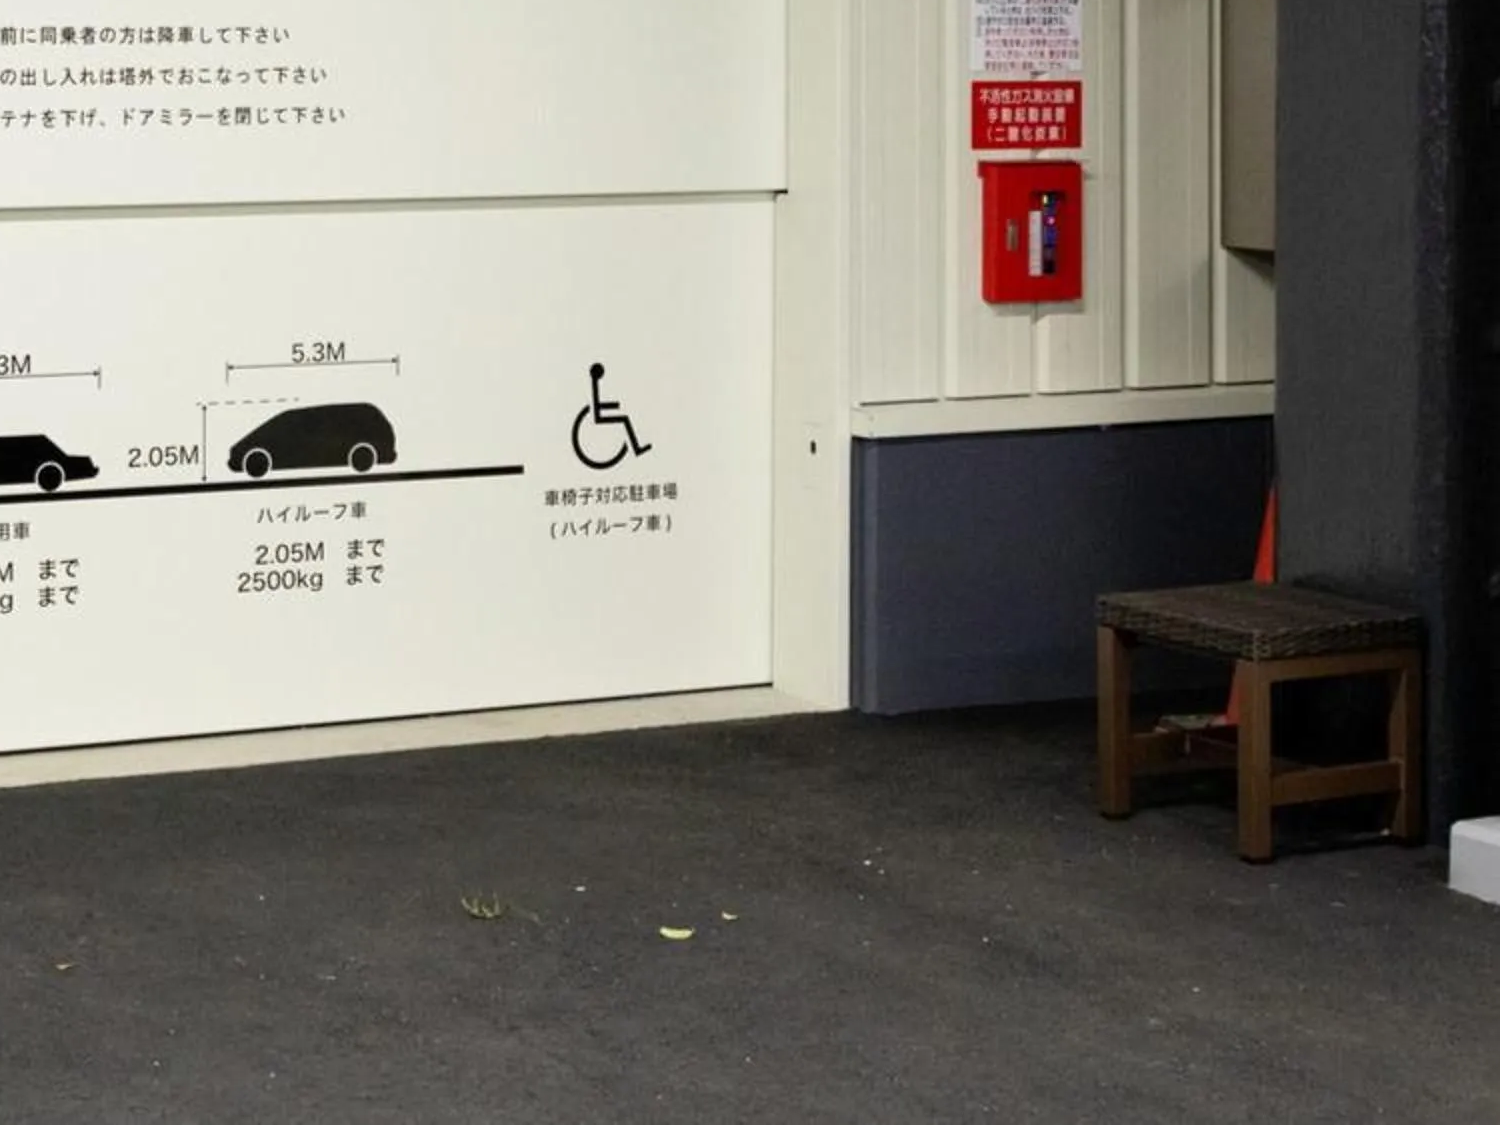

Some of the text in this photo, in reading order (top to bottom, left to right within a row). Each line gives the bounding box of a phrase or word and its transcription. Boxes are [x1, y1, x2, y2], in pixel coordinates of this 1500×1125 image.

[291, 341, 346, 361] 5.3M
[127, 444, 199, 469] 2.05M
[256, 500, 367, 524] ハイルーフ車
[255, 538, 385, 566] 2.05M まで
[38, 558, 79, 581] まで
[237, 564, 384, 594] 2500kg まで
[38, 585, 79, 608] まで
